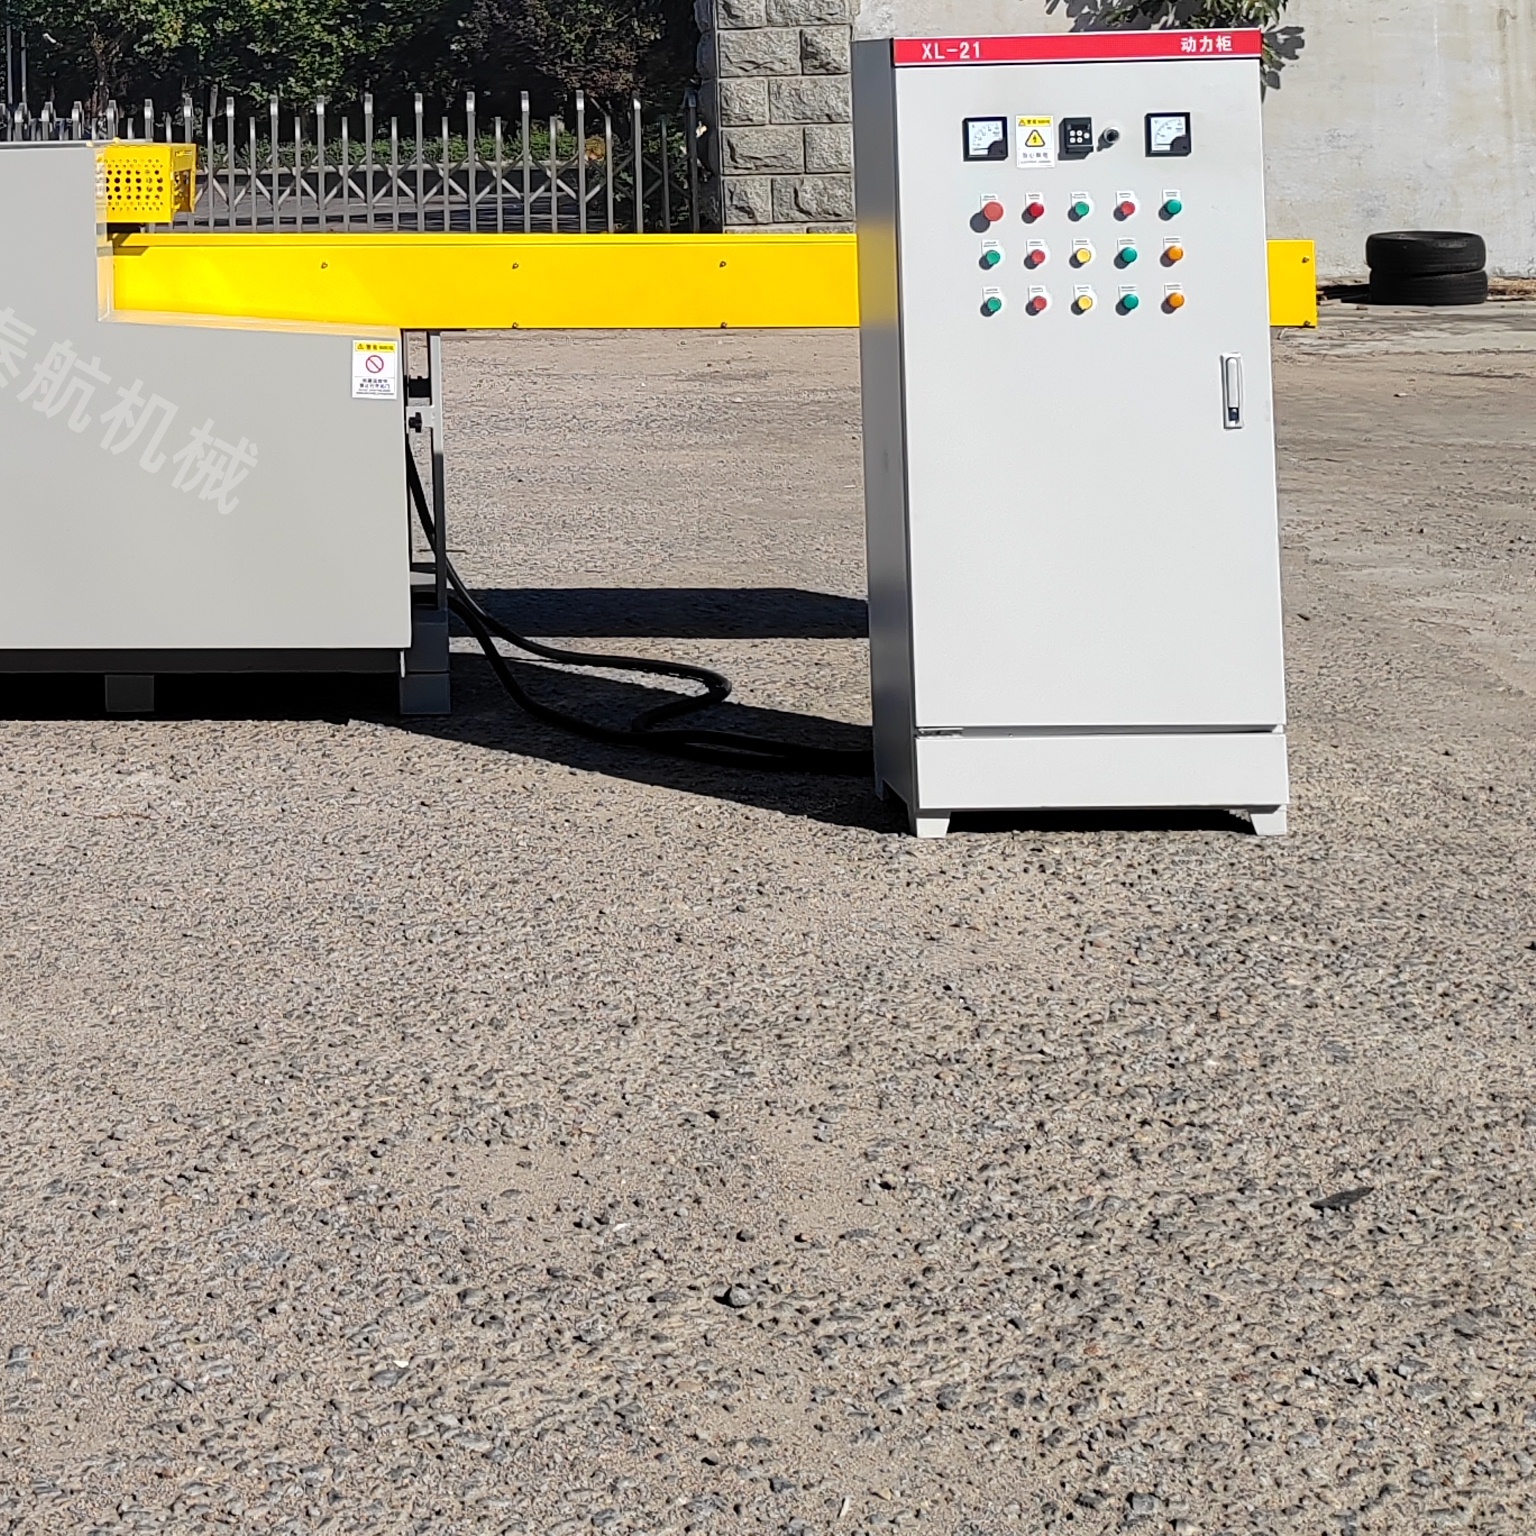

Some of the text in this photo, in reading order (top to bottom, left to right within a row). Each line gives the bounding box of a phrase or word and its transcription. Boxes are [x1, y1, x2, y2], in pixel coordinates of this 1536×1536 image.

[921, 41, 980, 60] XL-21
[1180, 35, 1233, 53] 动力柜
